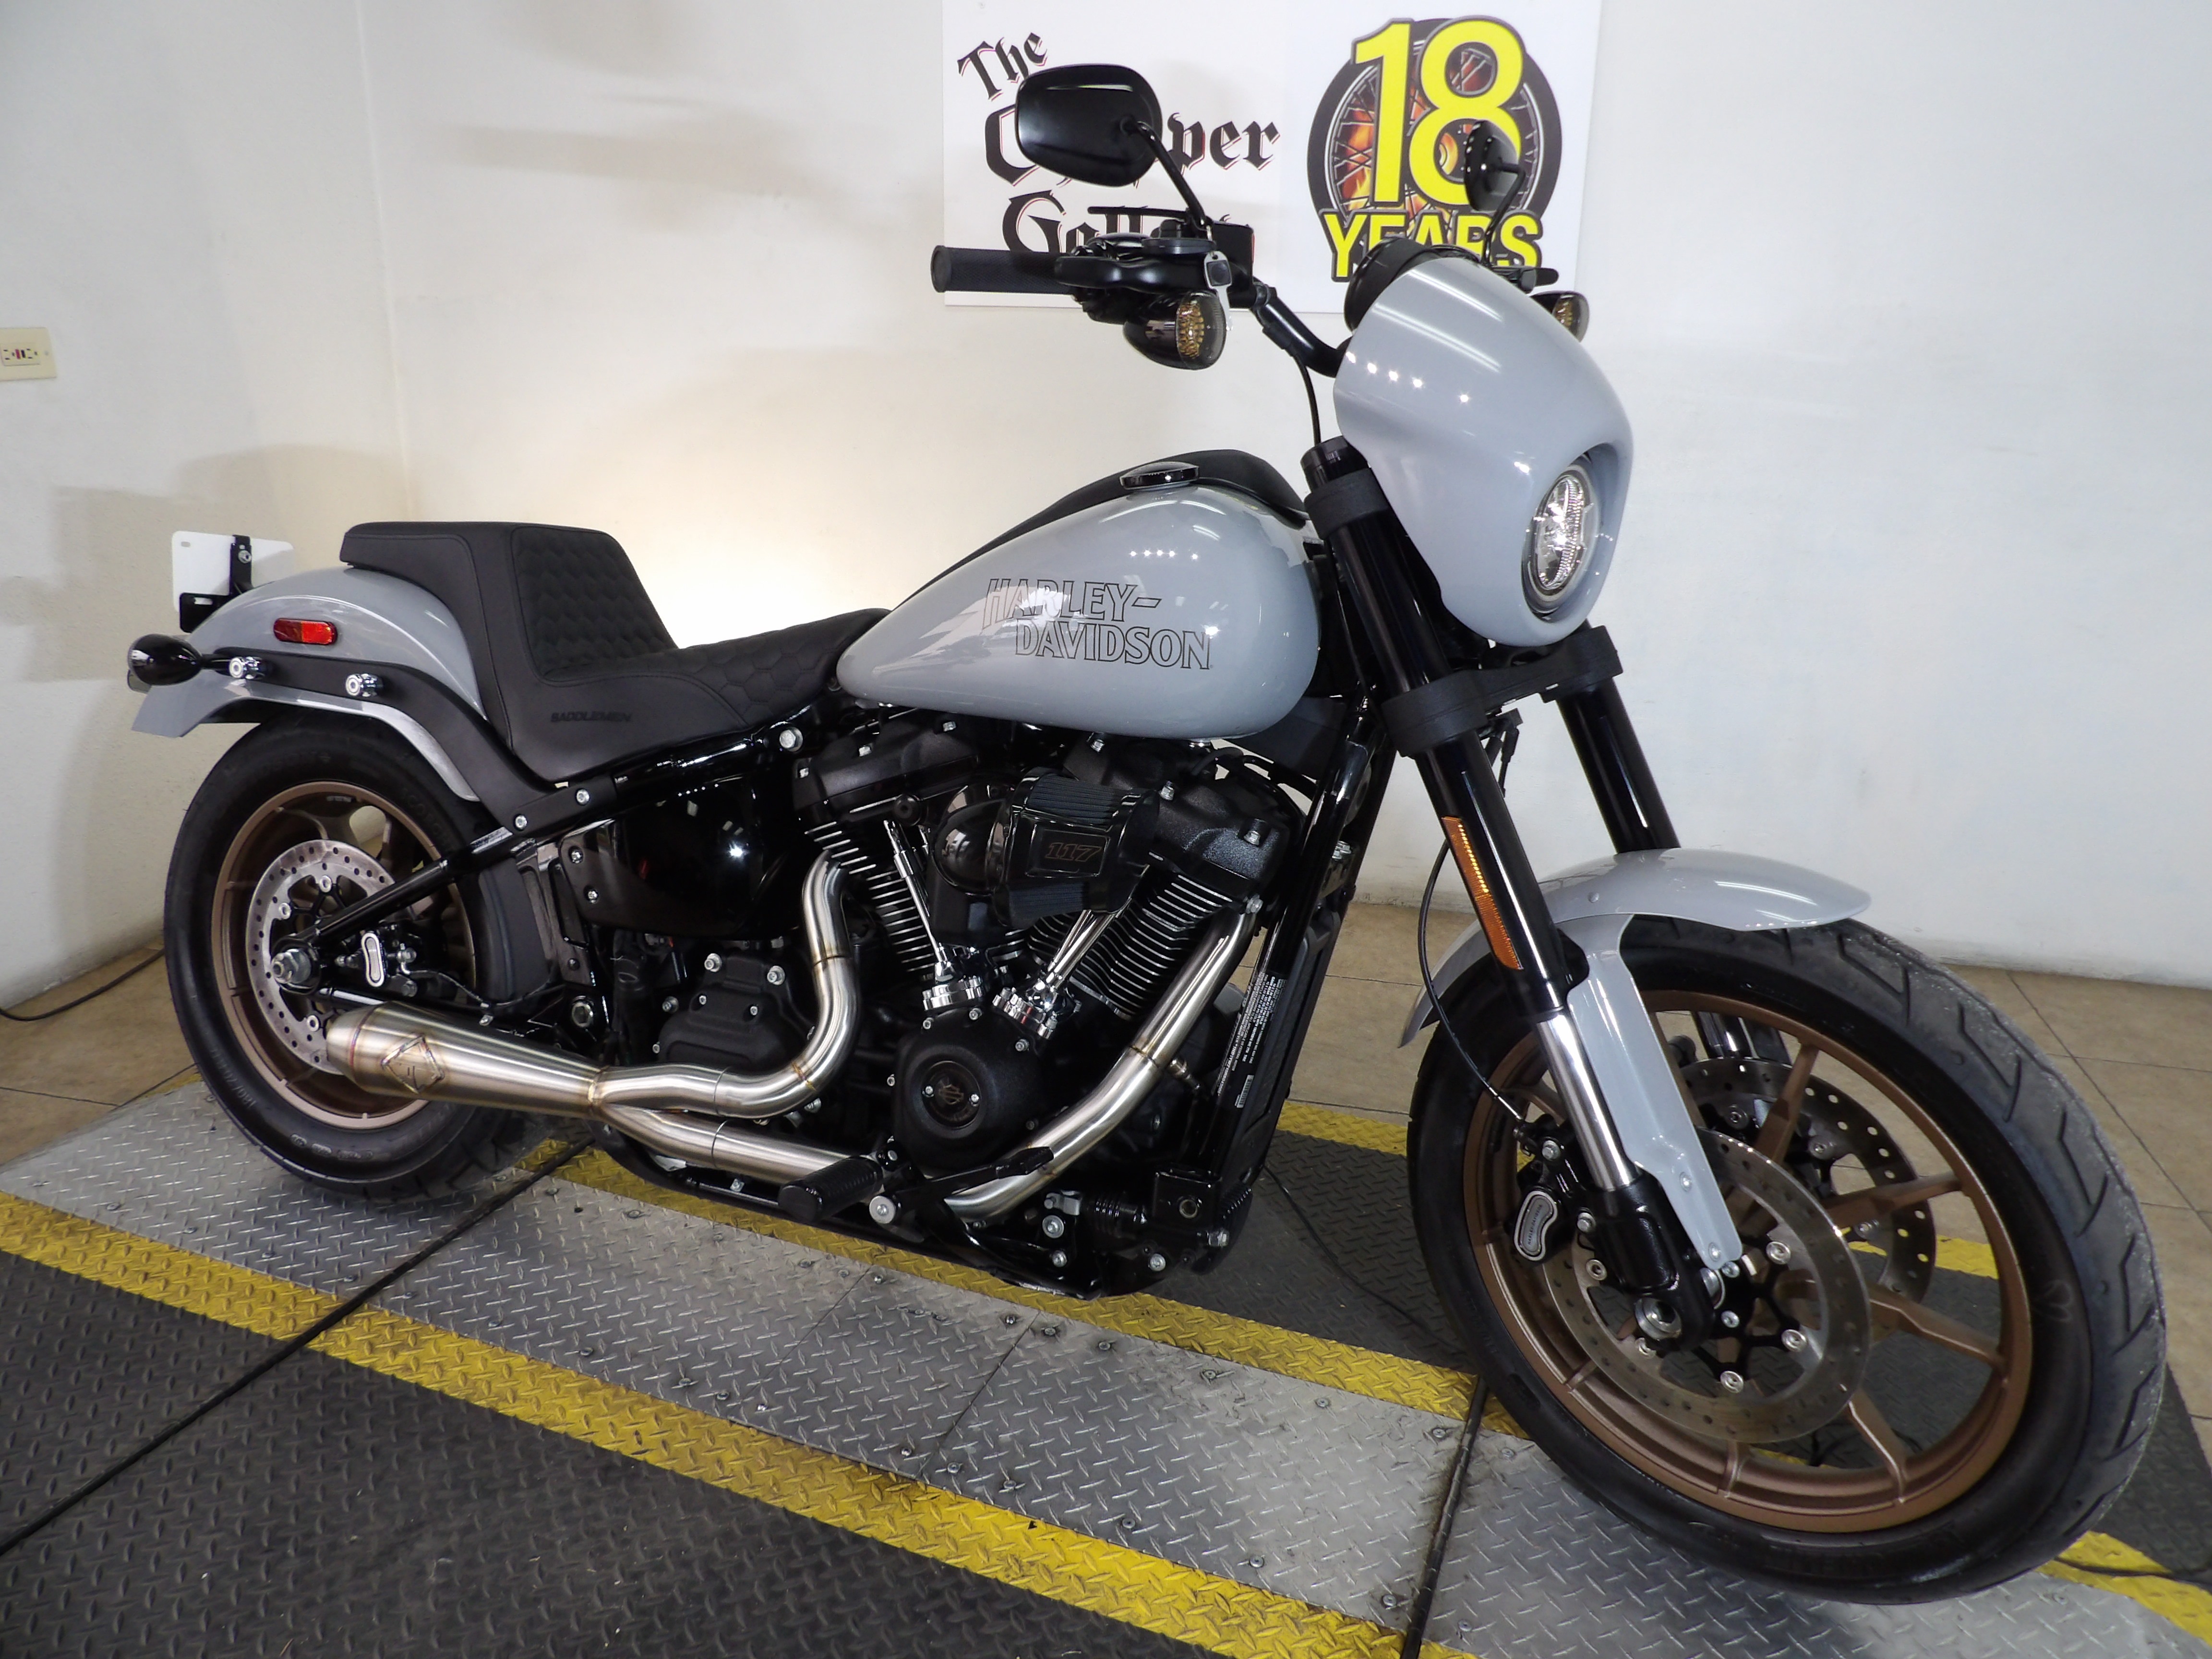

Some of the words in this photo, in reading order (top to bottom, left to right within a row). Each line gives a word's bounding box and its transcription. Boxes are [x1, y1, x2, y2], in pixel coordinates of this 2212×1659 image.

[957, 32, 1047, 101] The
[1354, 17, 1525, 206] 18
[985, 104, 1280, 188] Cper
[982, 578, 1162, 629] HARLEY-
[1015, 619, 1210, 670] DAVIDSON
[1045, 842, 1102, 862] 117
